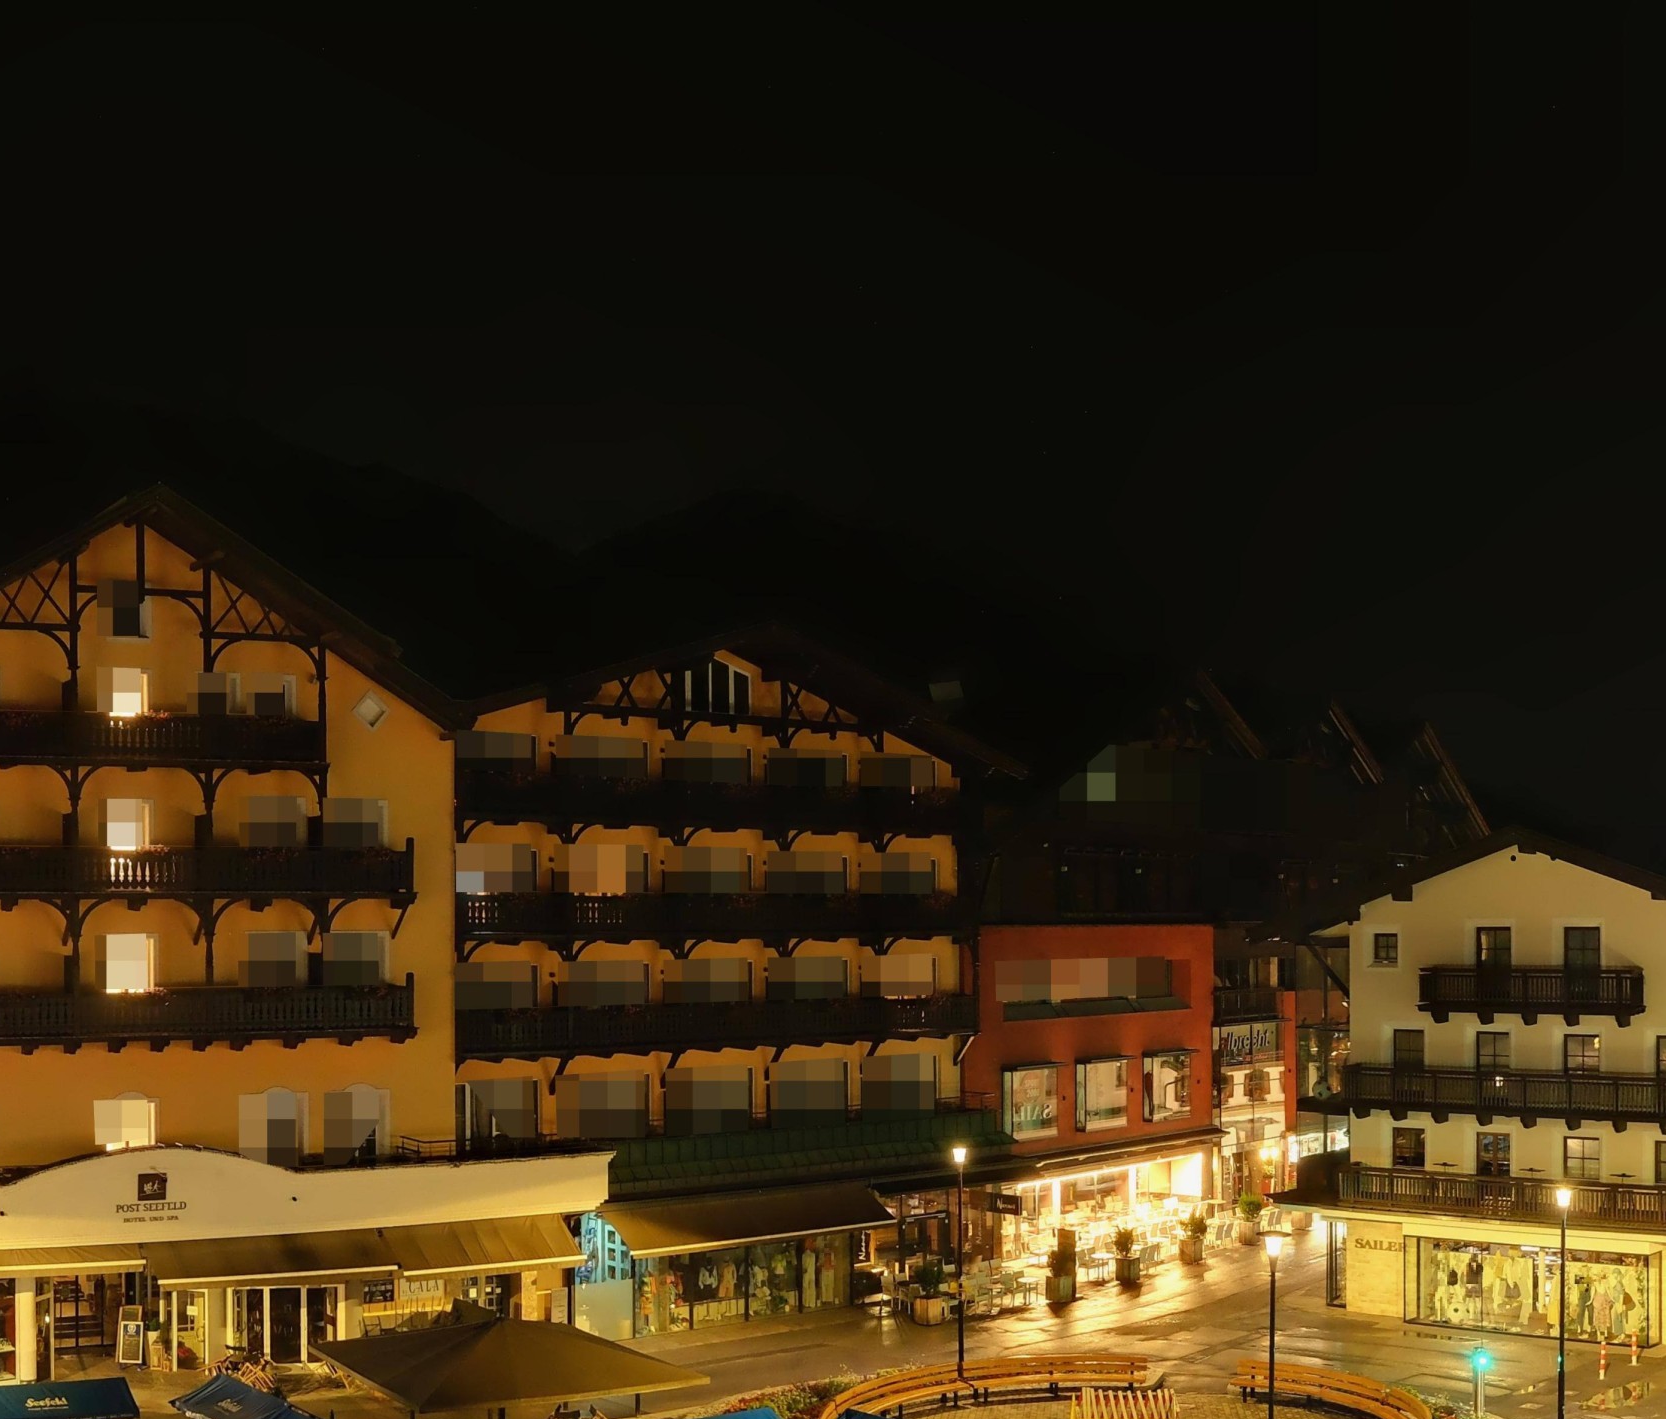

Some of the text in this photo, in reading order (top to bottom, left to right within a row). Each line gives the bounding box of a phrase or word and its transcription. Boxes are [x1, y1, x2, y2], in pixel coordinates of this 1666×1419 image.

[116, 1201, 187, 1213] POST SEEFELD
[25, 1396, 69, 1408] Seefeld
